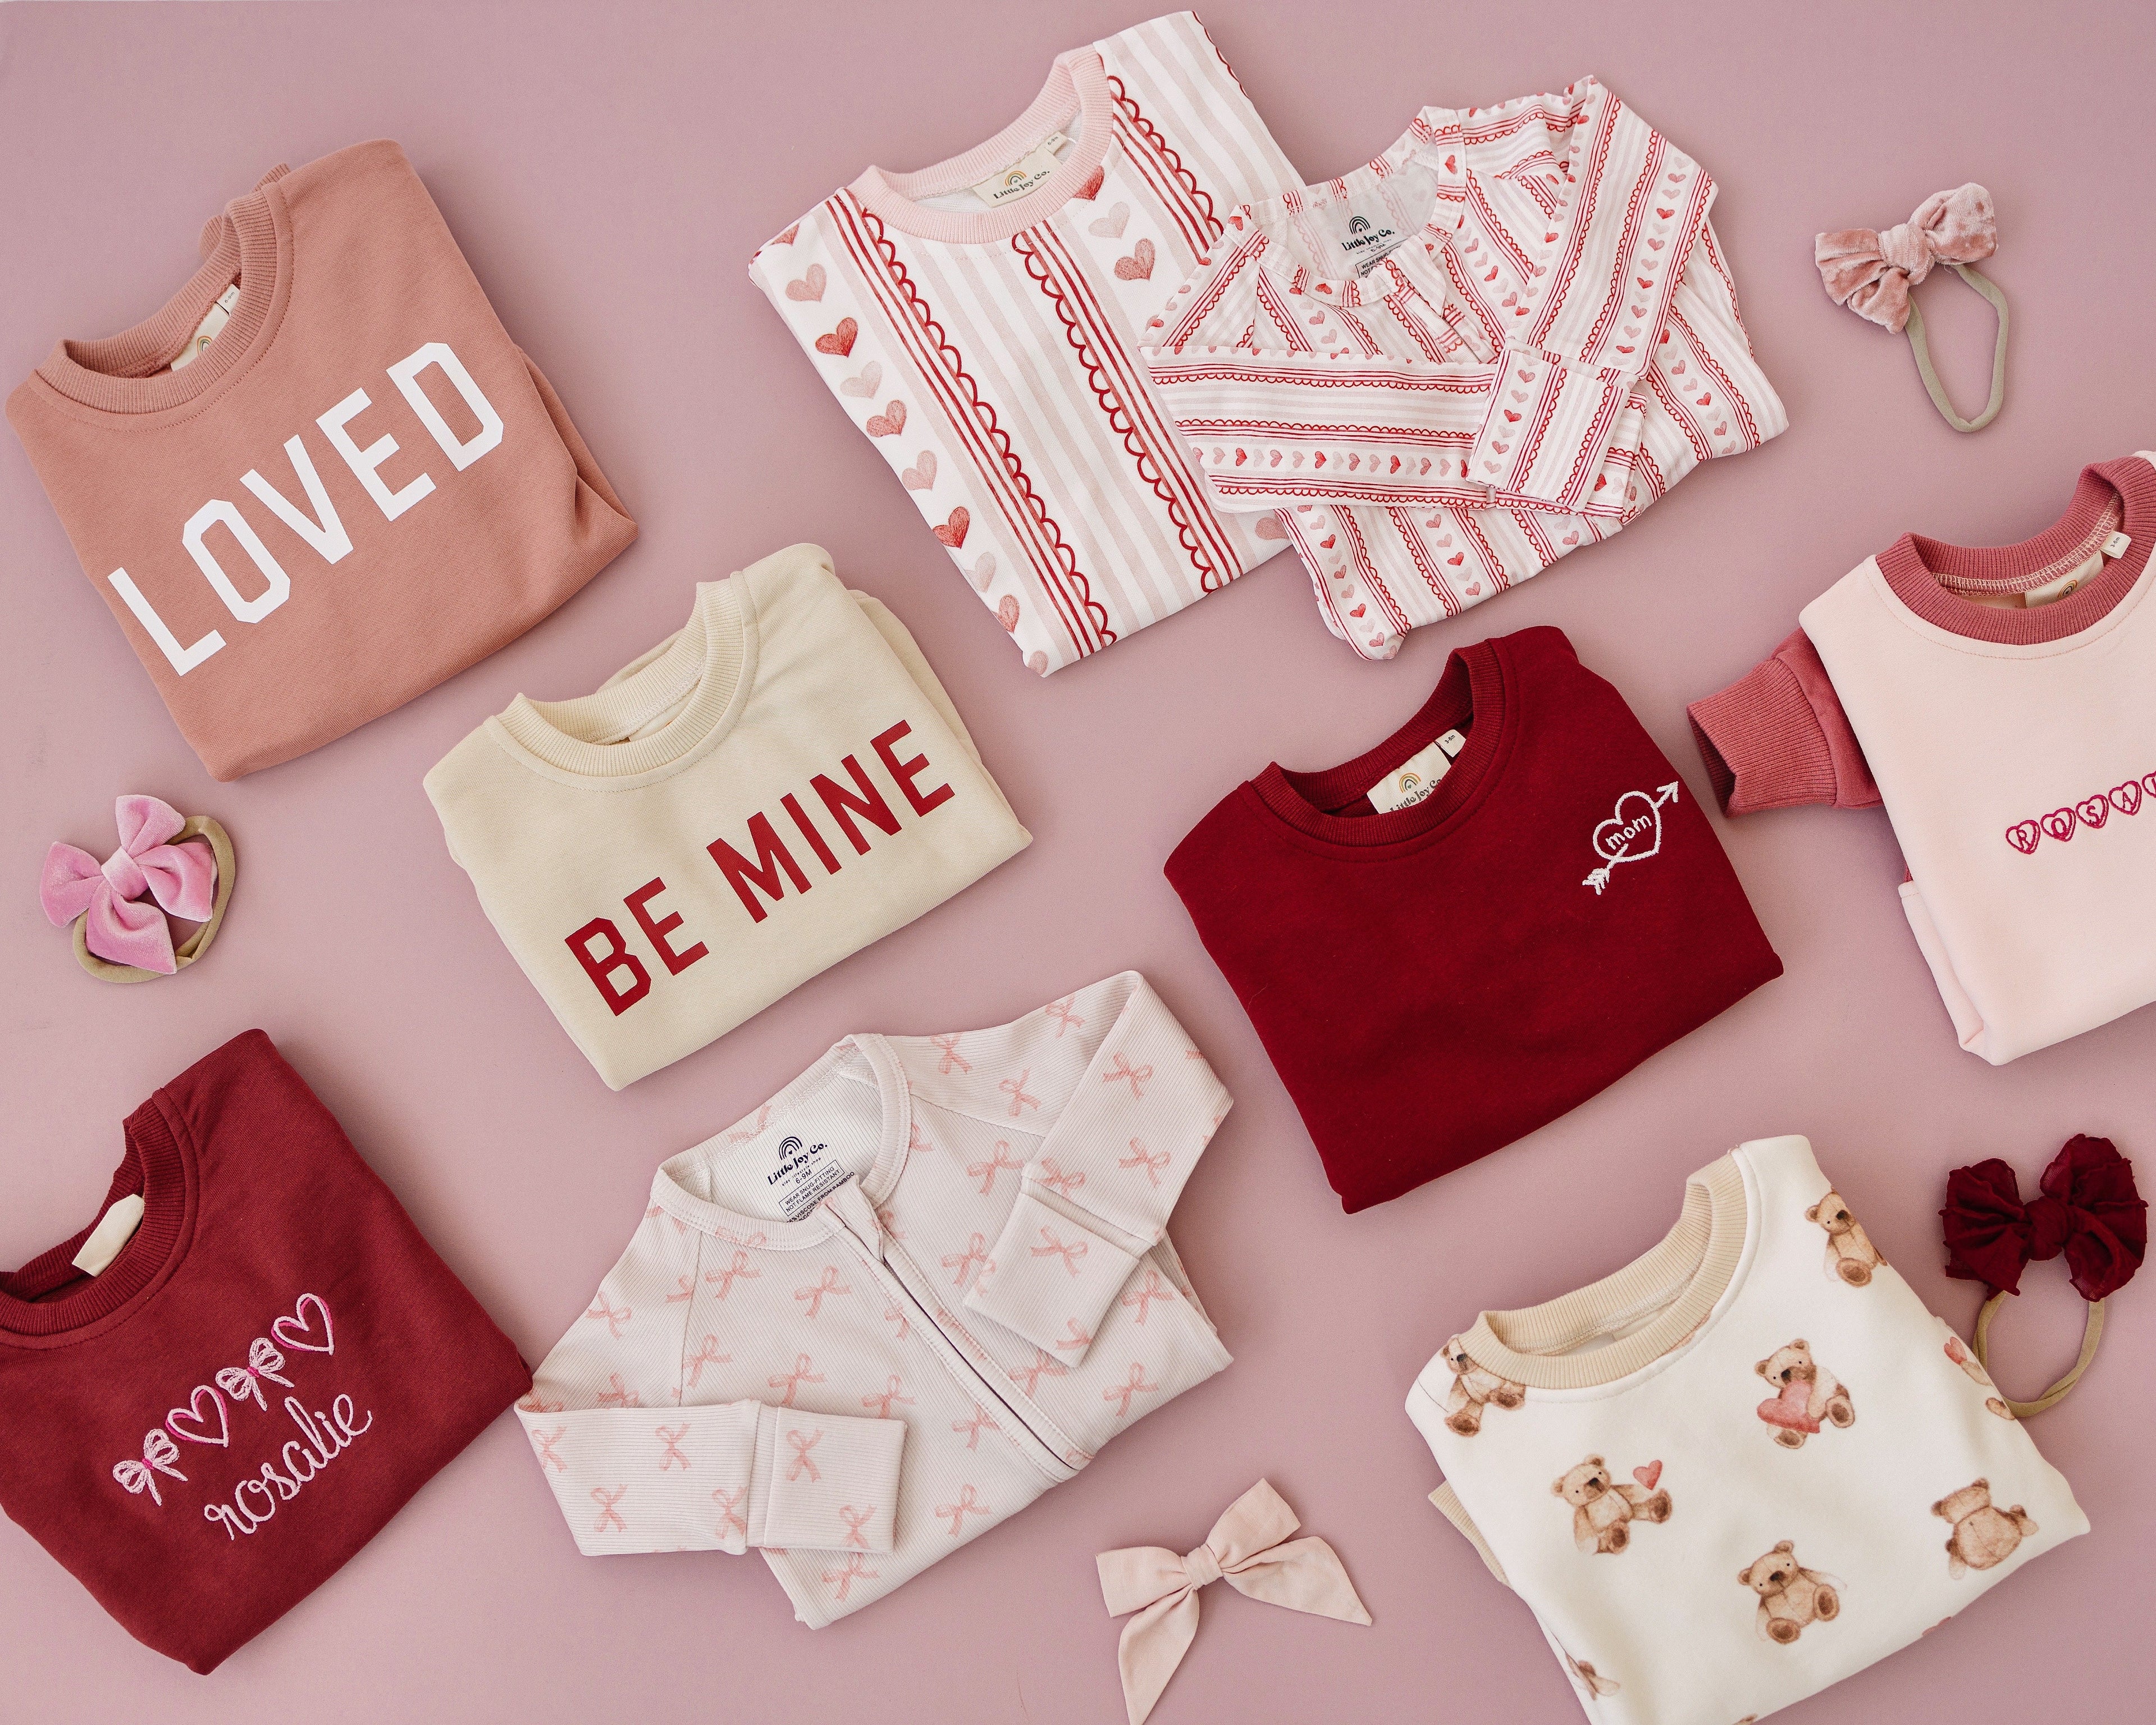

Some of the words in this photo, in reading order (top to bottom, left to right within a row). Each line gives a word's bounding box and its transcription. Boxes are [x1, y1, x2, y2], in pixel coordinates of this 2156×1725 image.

[993, 188, 1020, 199] Little
[1018, 180, 1034, 191] Joy
[1034, 170, 1050, 180] Co.
[1341, 238, 1365, 251] Little
[1364, 234, 1380, 245] Joy
[1378, 229, 1395, 237] Co.
[1362, 259, 1376, 269] WEAR
[224, 291, 235, 304] 6-9m
[107, 341, 504, 677] LOVED
[1414, 787, 1430, 801] Joy
[1605, 815, 1652, 850] mom
[564, 877, 710, 1017] BE
[706, 719, 956, 924] MINE
[767, 1164, 793, 1185] Little
[793, 1152, 808, 1169] Joy
[810, 1143, 828, 1154] Co.
[795, 1169, 812, 1184] 6-9M
[785, 1193, 800, 1206] WEAR
[800, 1166, 834, 1194] SNUG-FITTING
[785, 1202, 797, 1212] NOT
[796, 1190, 813, 1204] FLAME
[812, 1169, 840, 1192] RESISTANT
[795, 1200, 818, 1218] VISCOSE
[204, 1394, 373, 1541] rosalie
